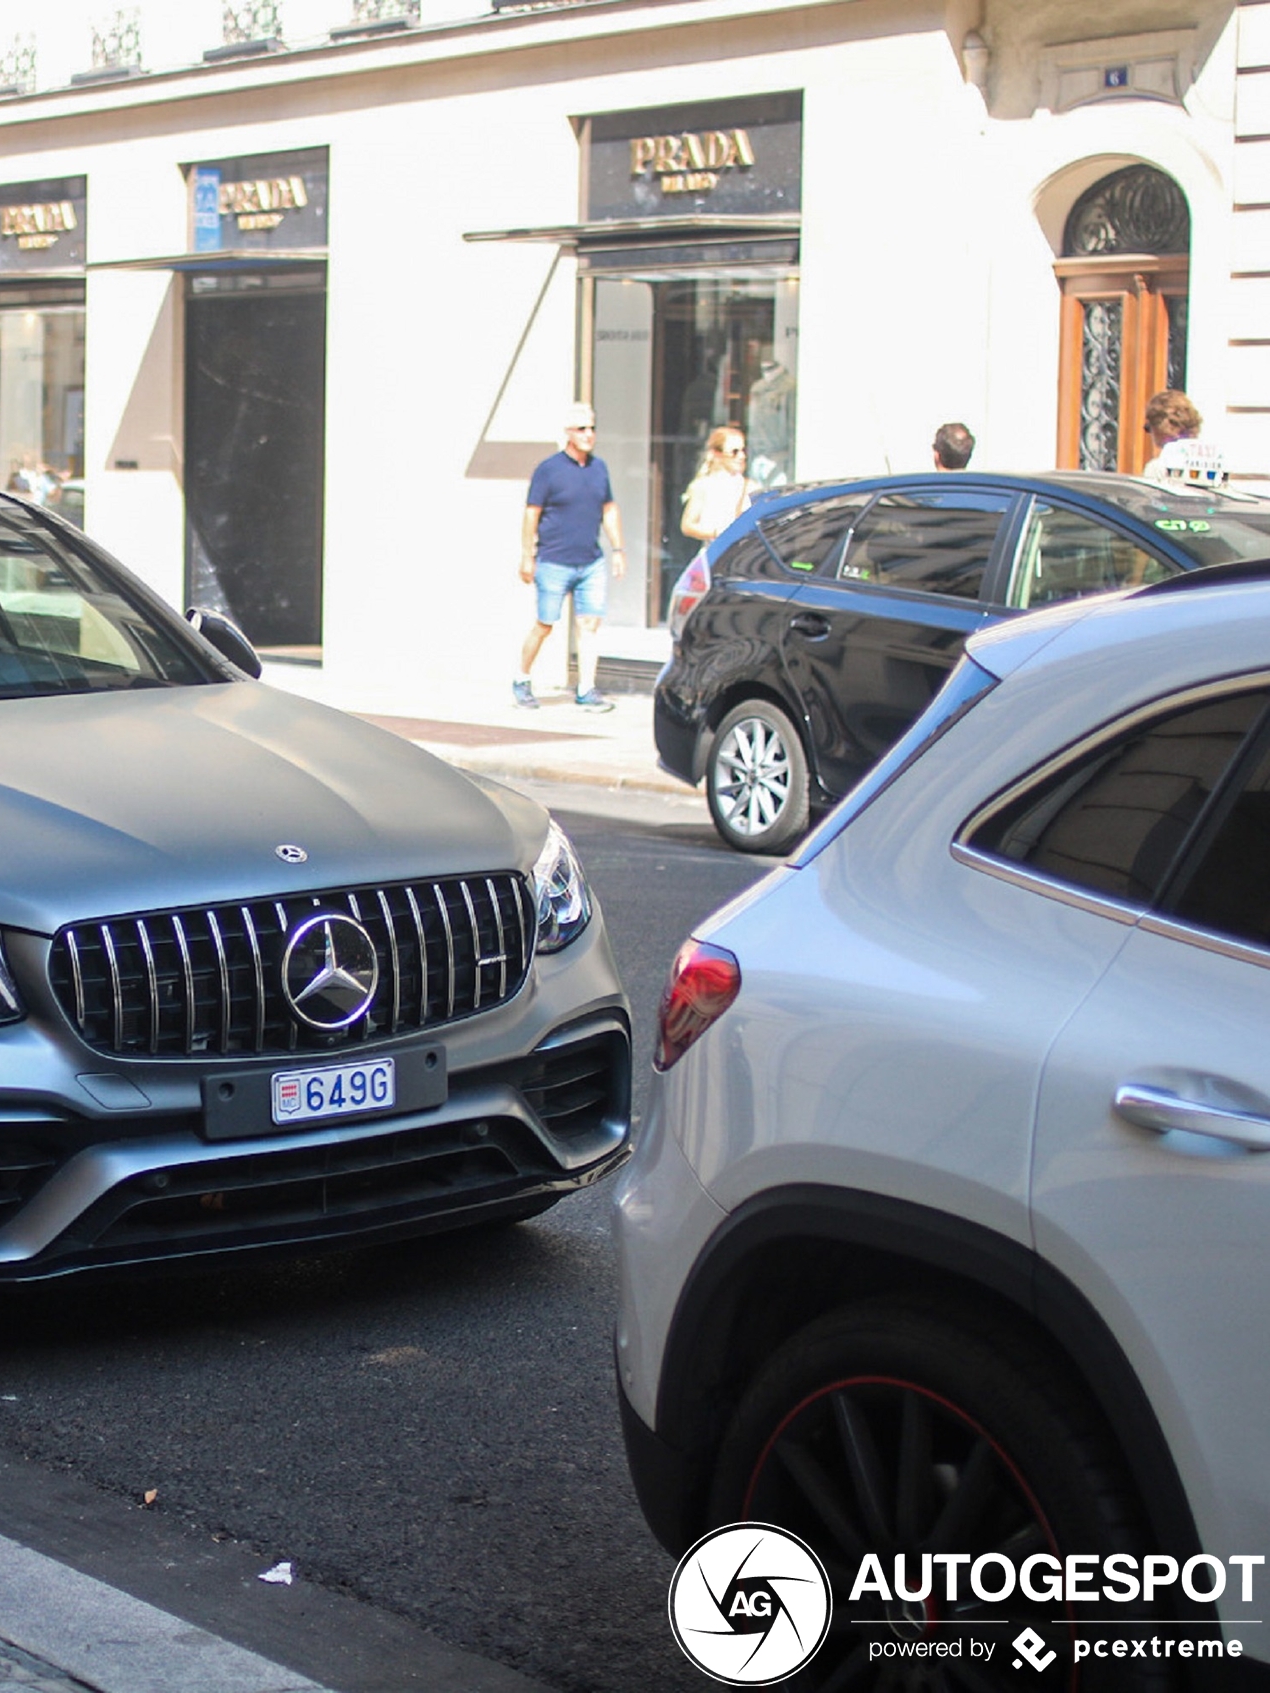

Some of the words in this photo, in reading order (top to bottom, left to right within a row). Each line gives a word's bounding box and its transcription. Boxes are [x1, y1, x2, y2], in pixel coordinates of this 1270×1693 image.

[630, 128, 755, 174] PRADA
[218, 174, 308, 215] PRADA
[306, 1067, 387, 1112] 649G
